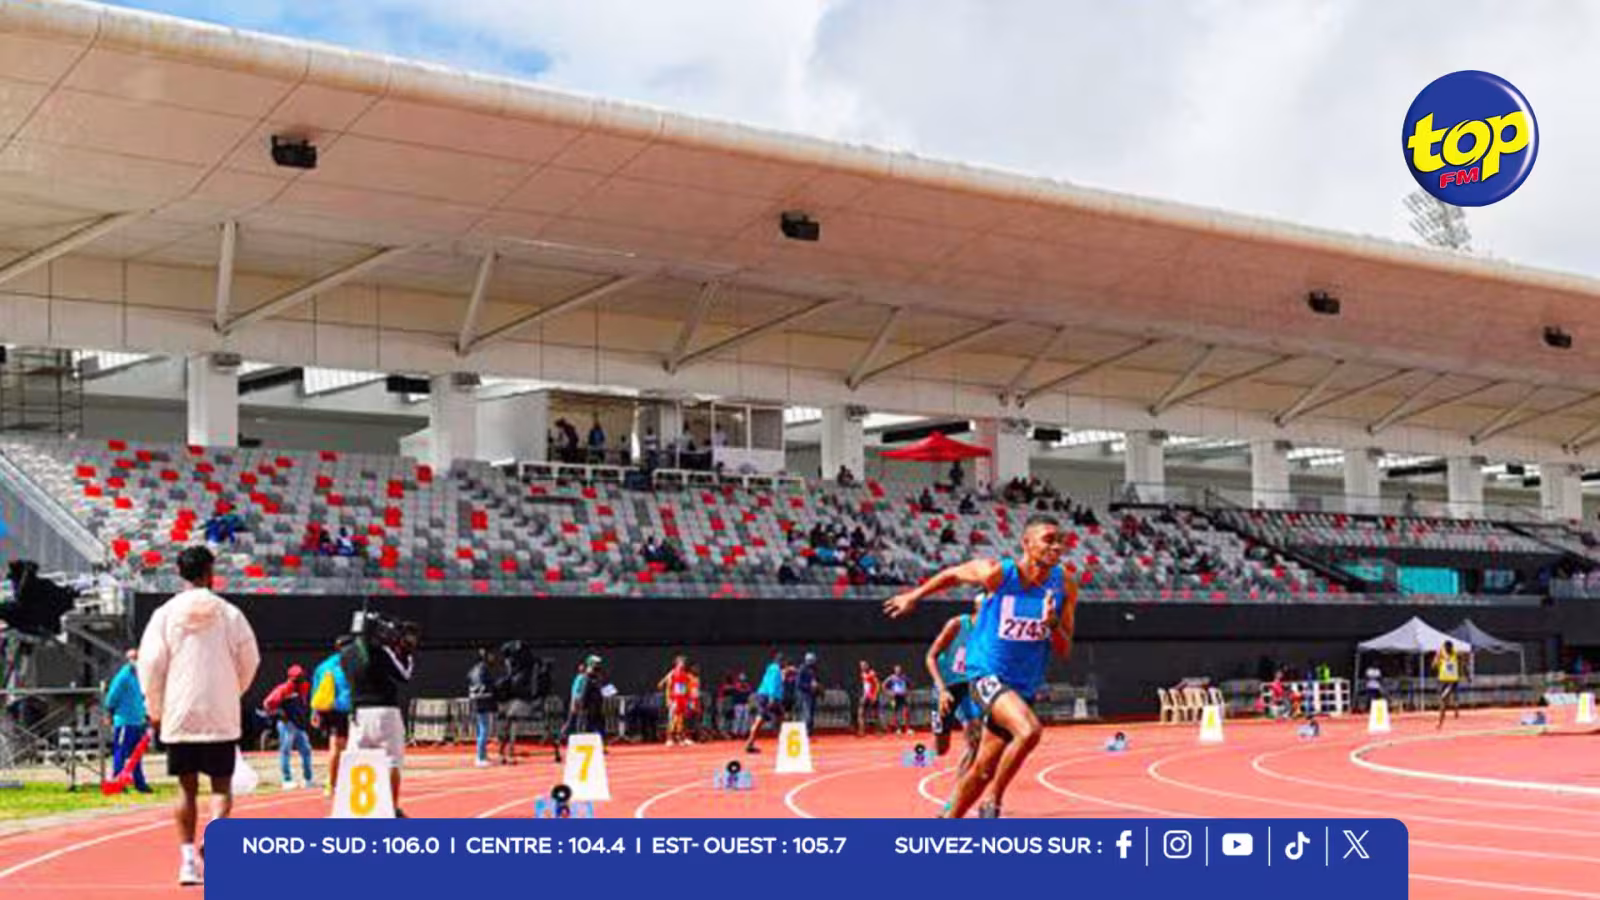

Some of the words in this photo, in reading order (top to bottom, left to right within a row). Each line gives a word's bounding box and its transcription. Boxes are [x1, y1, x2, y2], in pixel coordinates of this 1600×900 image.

[575, 744, 594, 781] 7
[786, 730, 802, 758] 6
[349, 764, 377, 817] 8
